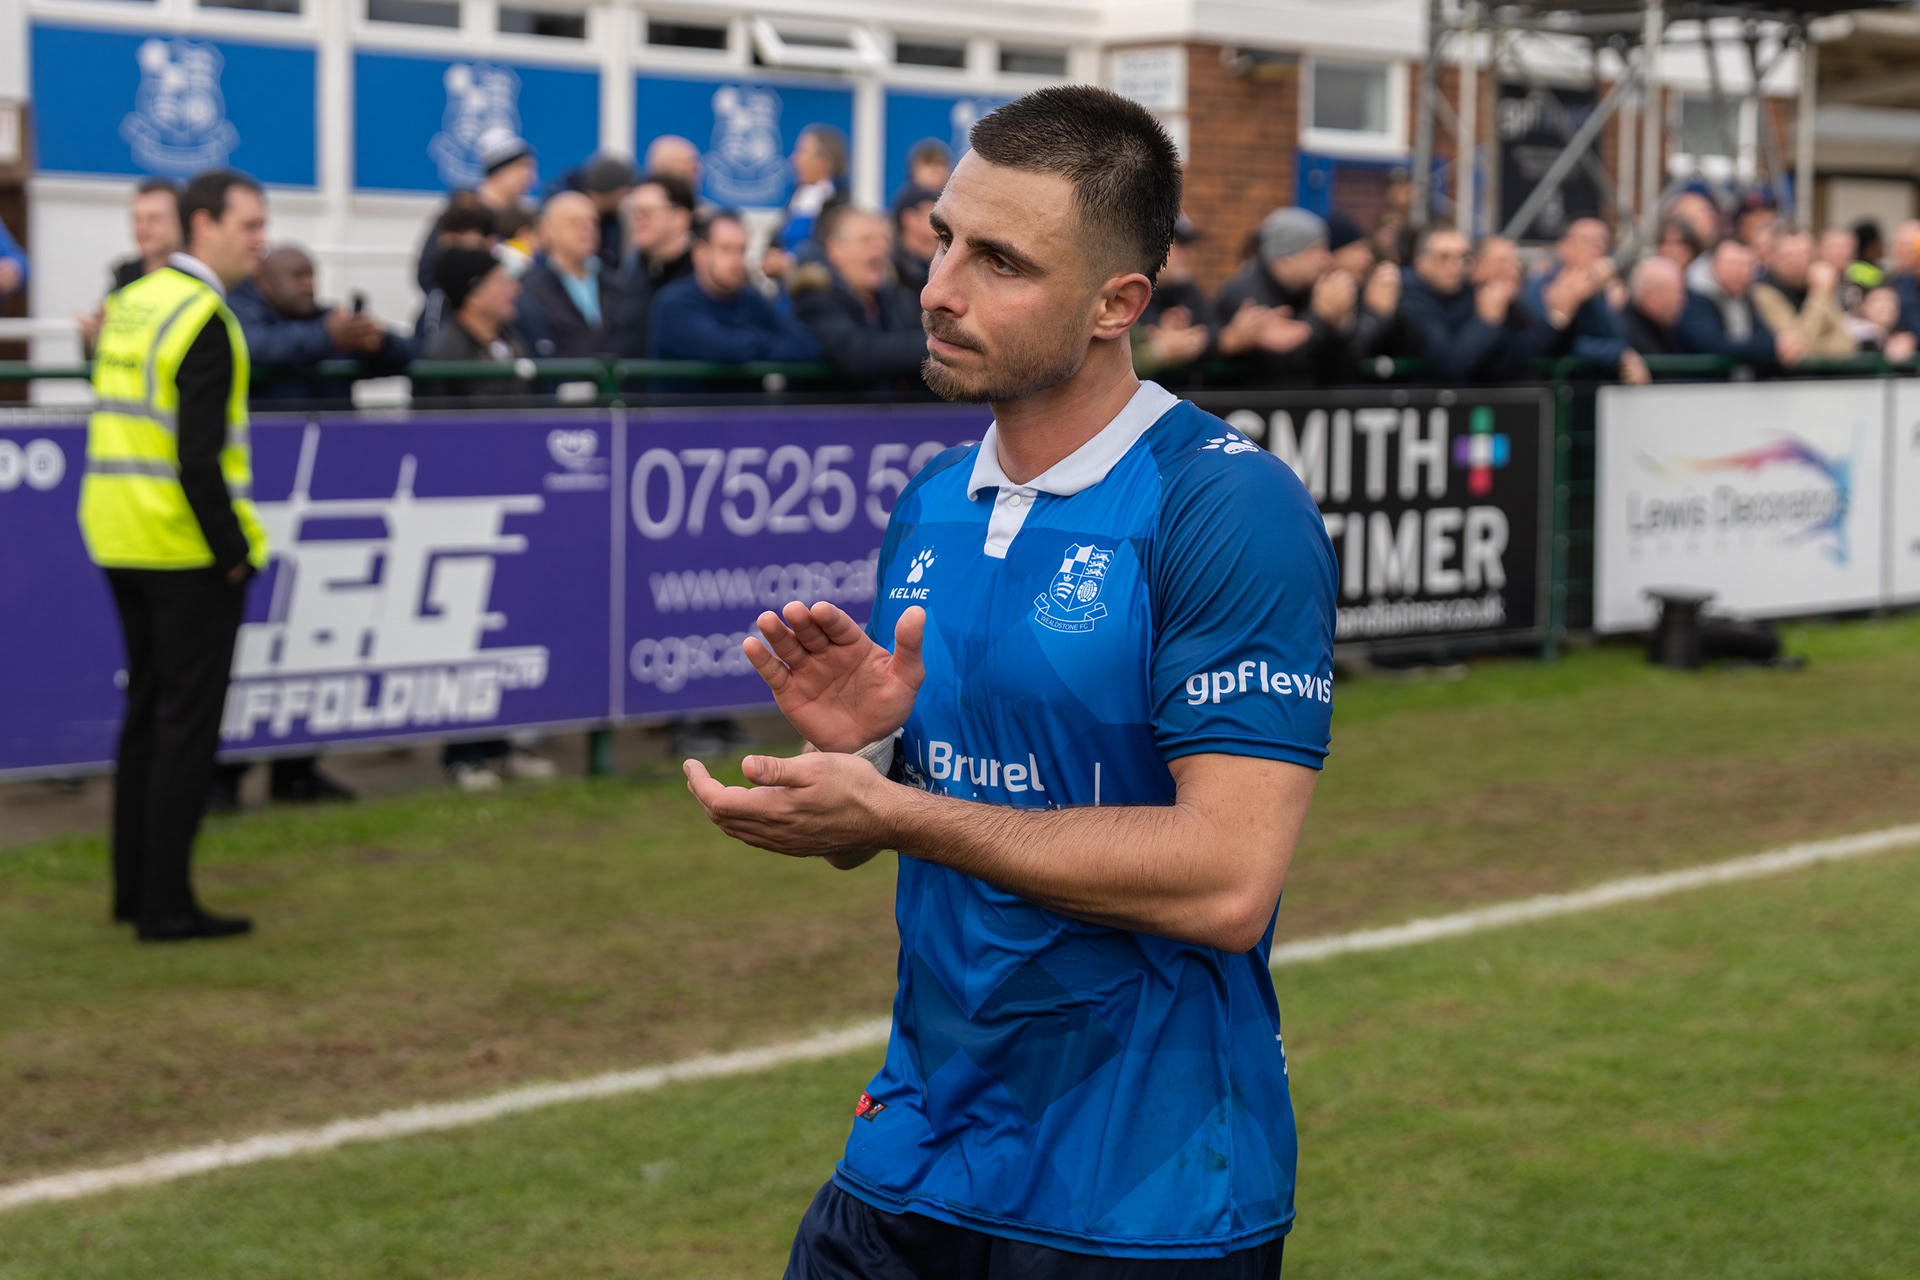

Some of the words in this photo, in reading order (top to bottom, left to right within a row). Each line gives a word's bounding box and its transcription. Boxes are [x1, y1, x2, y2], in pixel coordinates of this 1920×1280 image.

[631, 444, 857, 540] 07525
[1627, 489, 1708, 537] Lewis
[889, 588, 930, 599] KELME
[1040, 614, 1078, 631] WEALDSTONE
[1080, 622, 1089, 630] FC
[629, 632, 764, 694] cgsca
